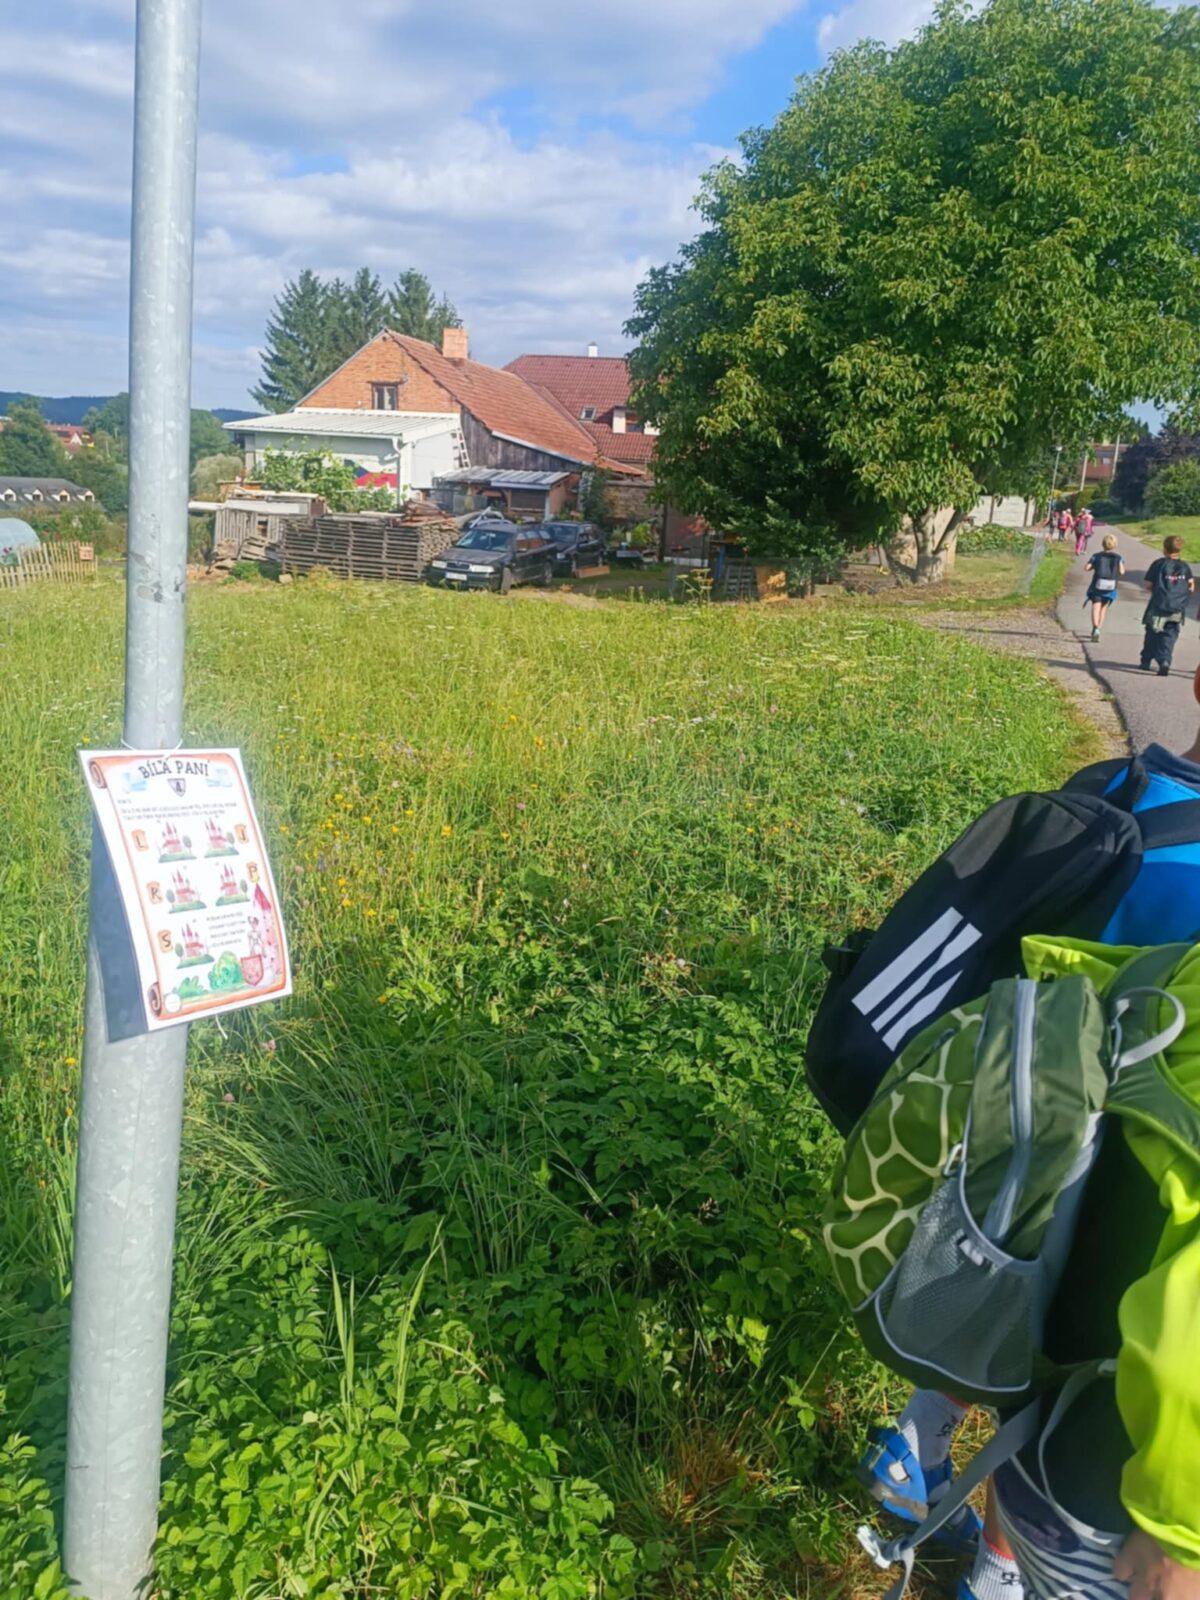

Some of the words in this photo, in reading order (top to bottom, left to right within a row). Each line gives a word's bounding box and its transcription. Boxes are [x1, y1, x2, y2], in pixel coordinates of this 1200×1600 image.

[135, 834, 145, 849] L
[151, 887, 163, 901] R
[160, 933, 172, 948] S
